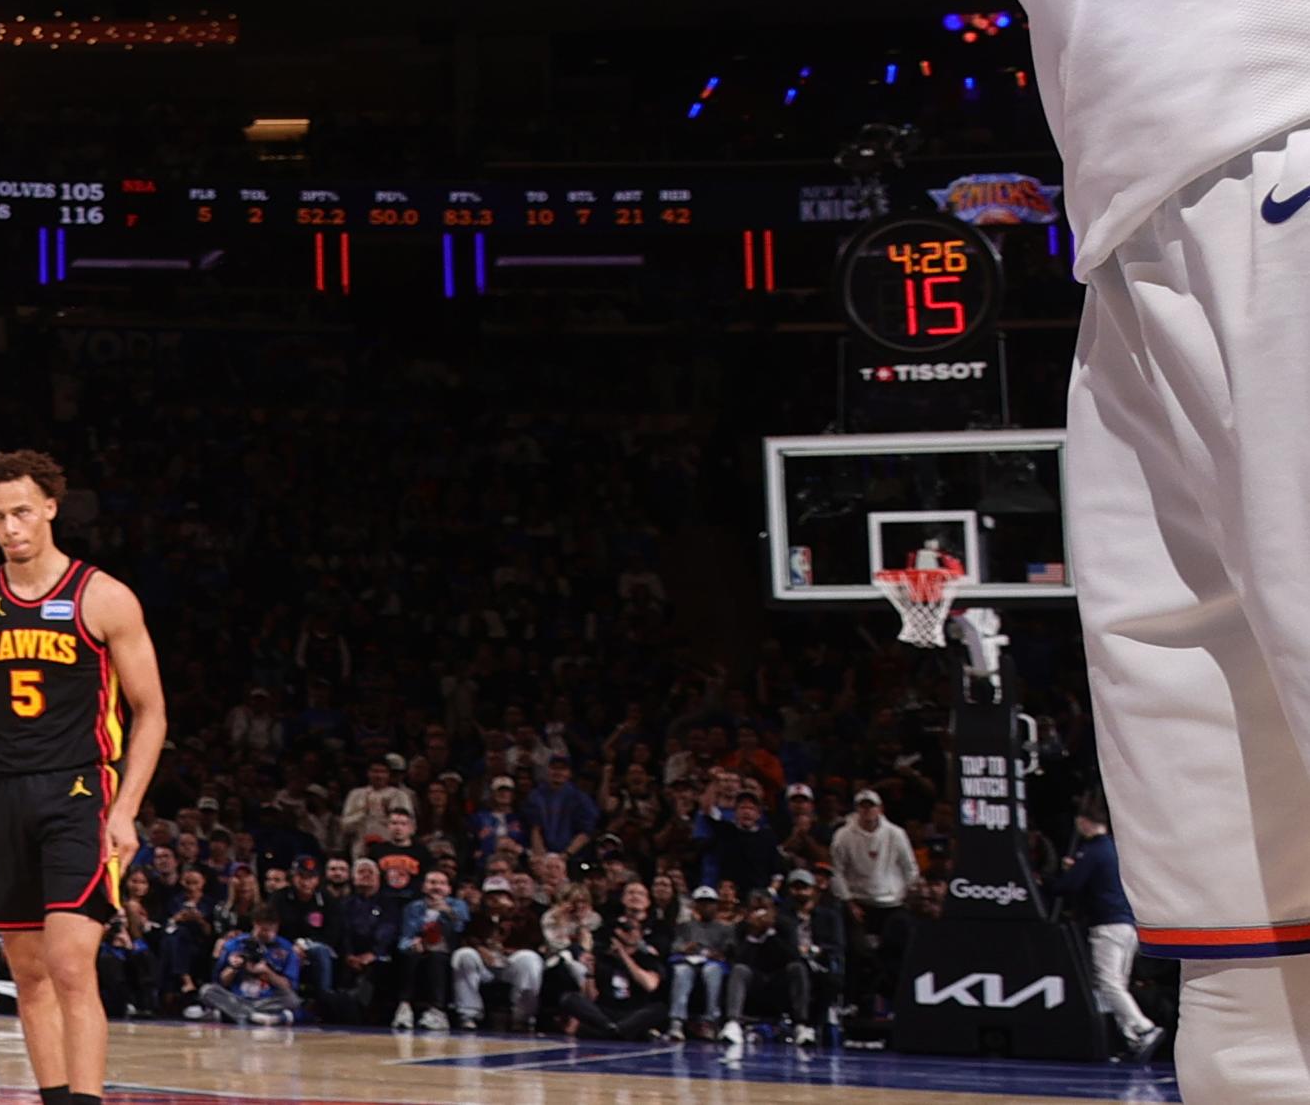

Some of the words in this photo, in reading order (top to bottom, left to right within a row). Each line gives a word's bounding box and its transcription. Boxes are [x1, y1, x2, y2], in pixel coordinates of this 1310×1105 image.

[59, 183, 105, 202] 105
[59, 205, 105, 225] 116
[887, 239, 968, 275] 4:26
[904, 275, 968, 337] 15
[9, 668, 46, 718] 5
[949, 877, 1029, 906] Google
[913, 971, 1066, 1011] KIA
